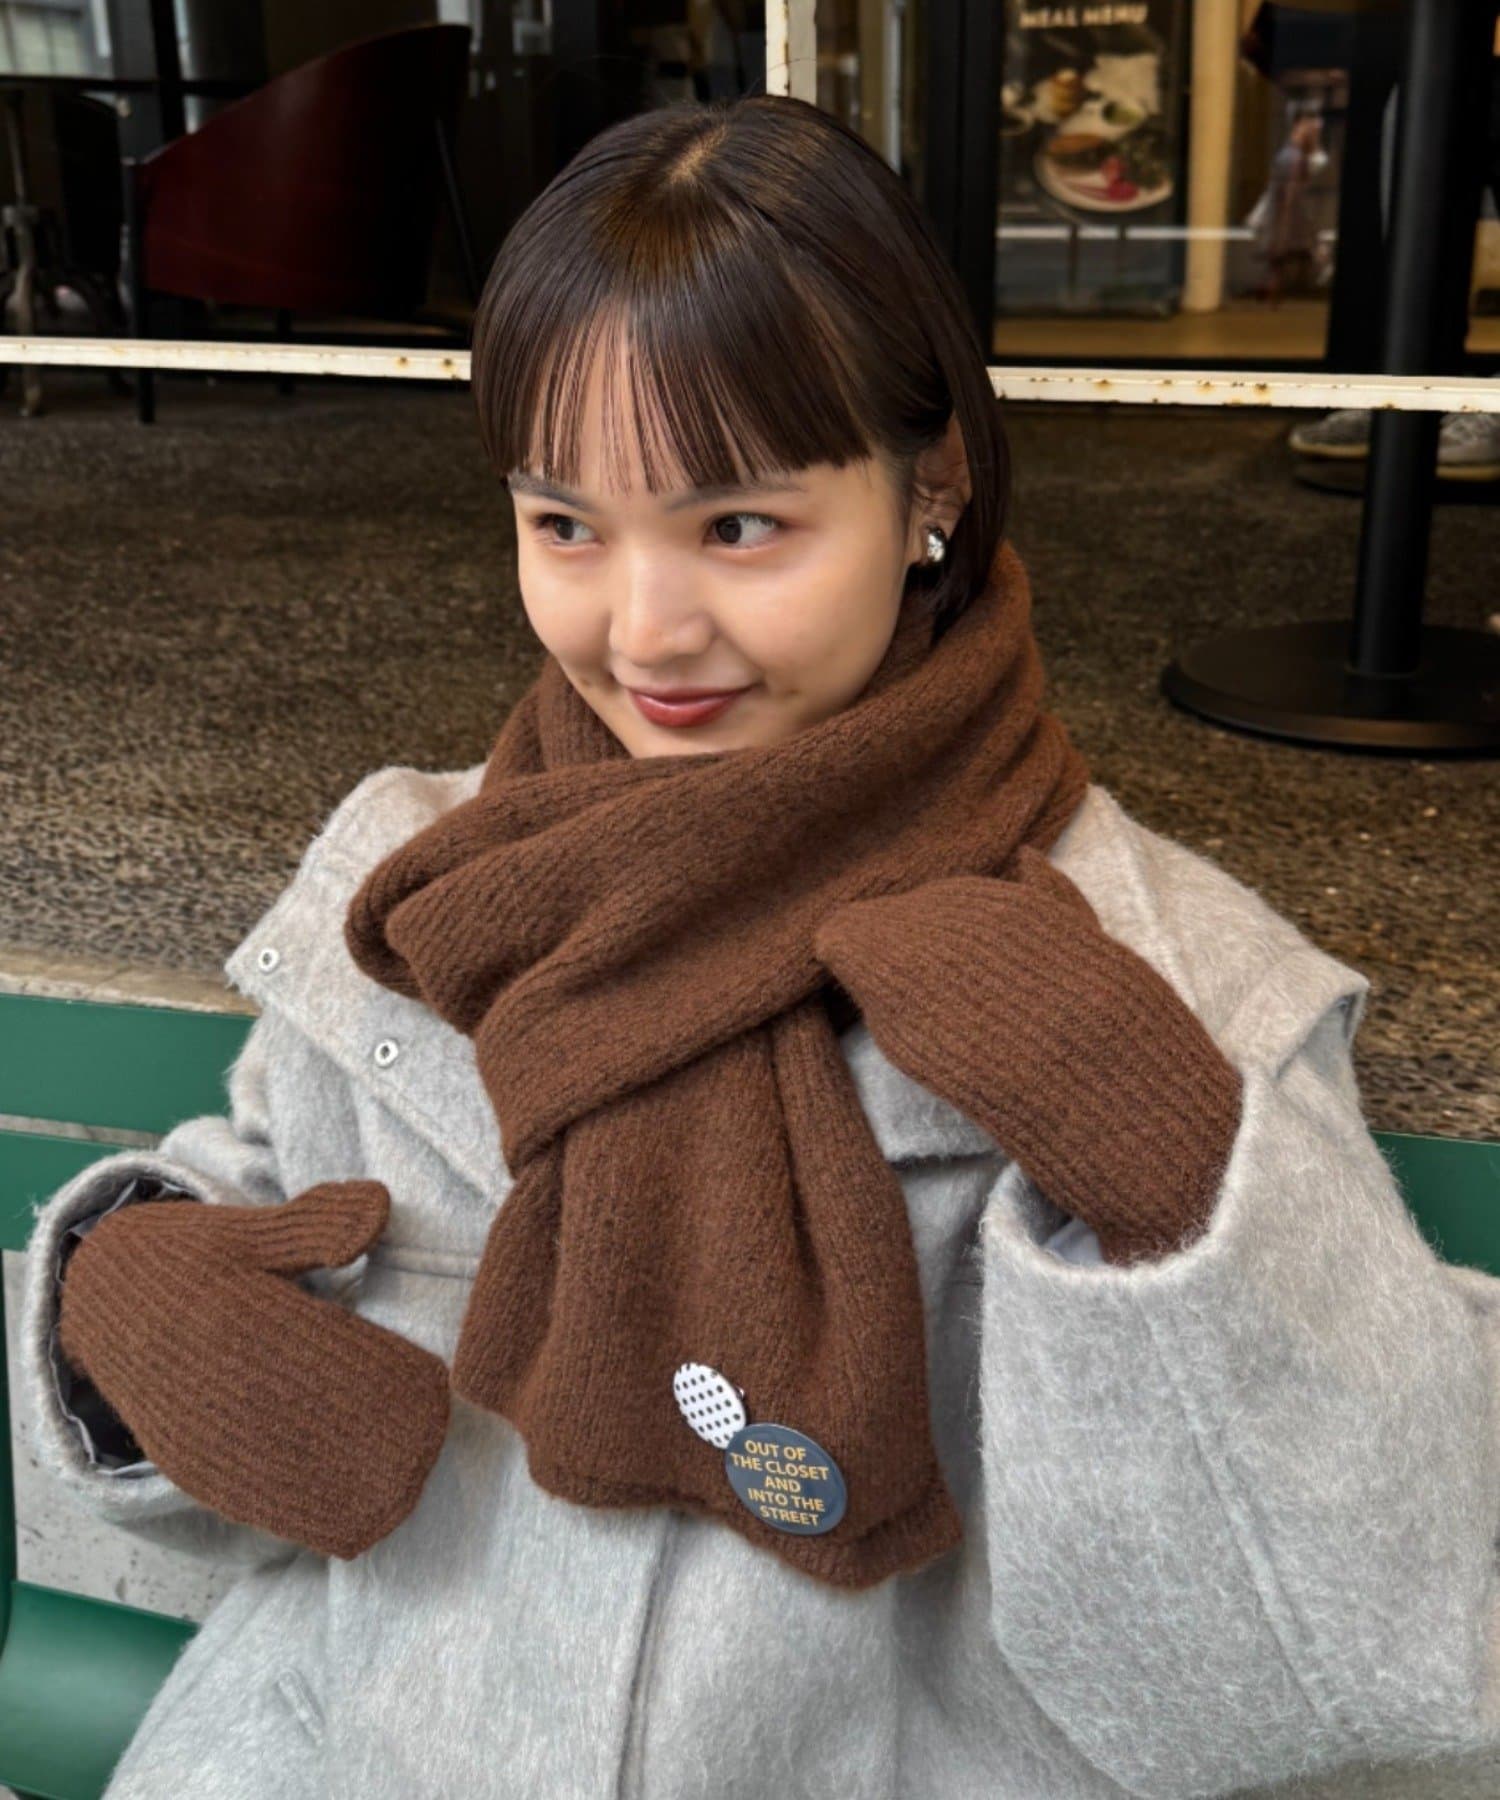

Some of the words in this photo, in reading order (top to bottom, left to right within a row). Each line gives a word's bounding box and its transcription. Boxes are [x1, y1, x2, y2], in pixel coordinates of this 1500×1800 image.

[745, 1440, 779, 1457] OUT
[783, 1446, 806, 1461] OF
[730, 1453, 762, 1471] THE
[765, 1461, 829, 1481] CLOSET
[765, 1477, 801, 1493] AND
[747, 1488, 788, 1505] INTO
[791, 1497, 825, 1512] THE
[760, 1506, 819, 1526] STREET
